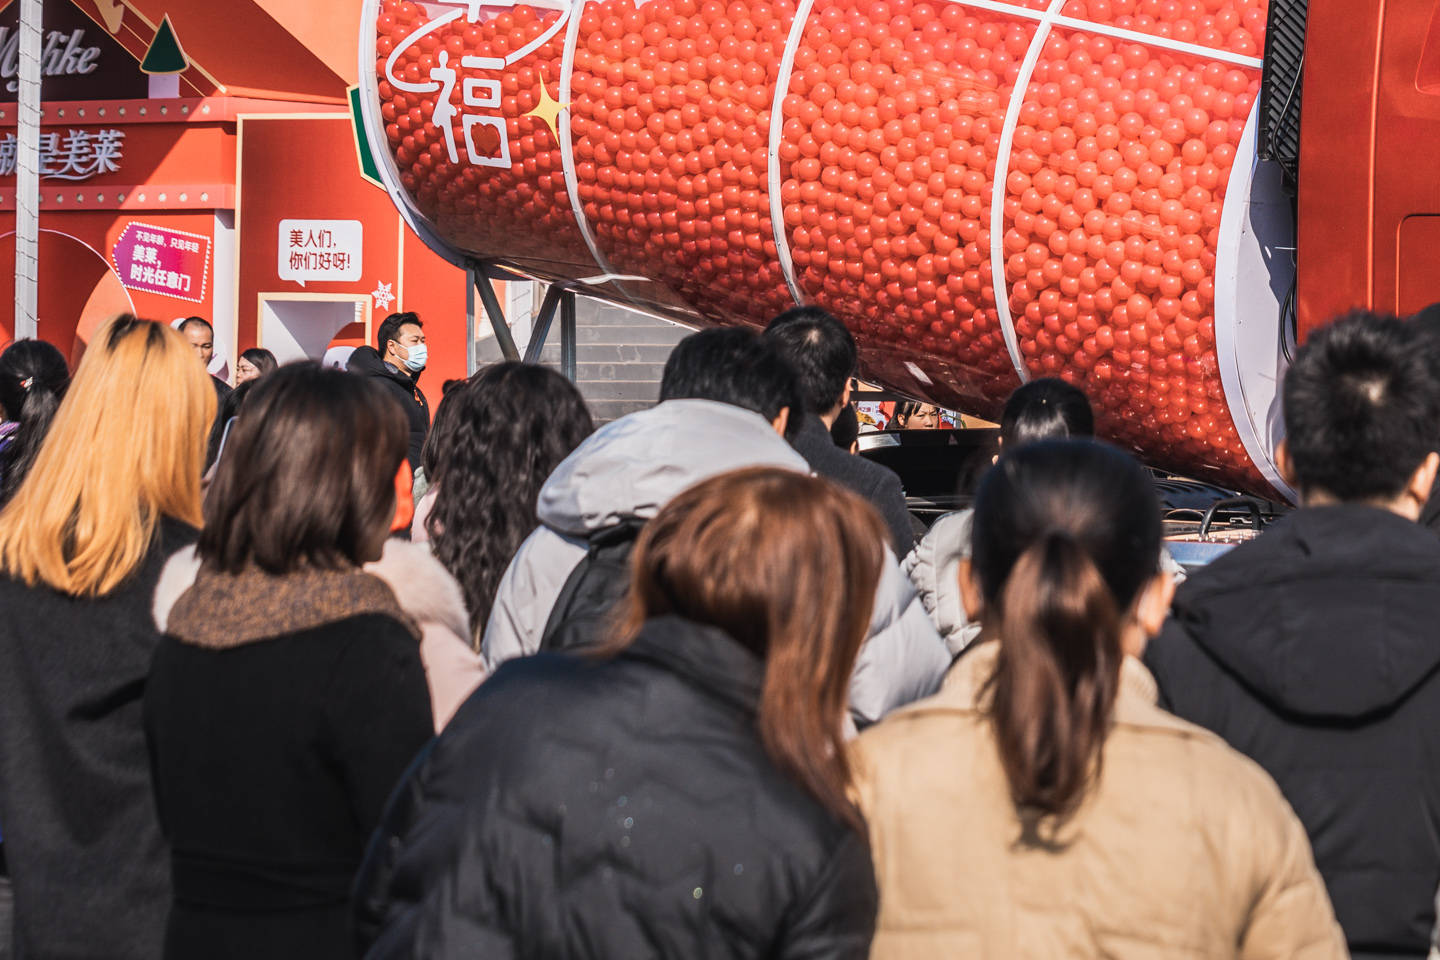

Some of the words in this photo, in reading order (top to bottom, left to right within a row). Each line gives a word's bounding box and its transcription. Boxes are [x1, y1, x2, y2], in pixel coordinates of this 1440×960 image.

[289, 251, 351, 271] 你们好呀！
[130, 263, 192, 292] 时光任意门
